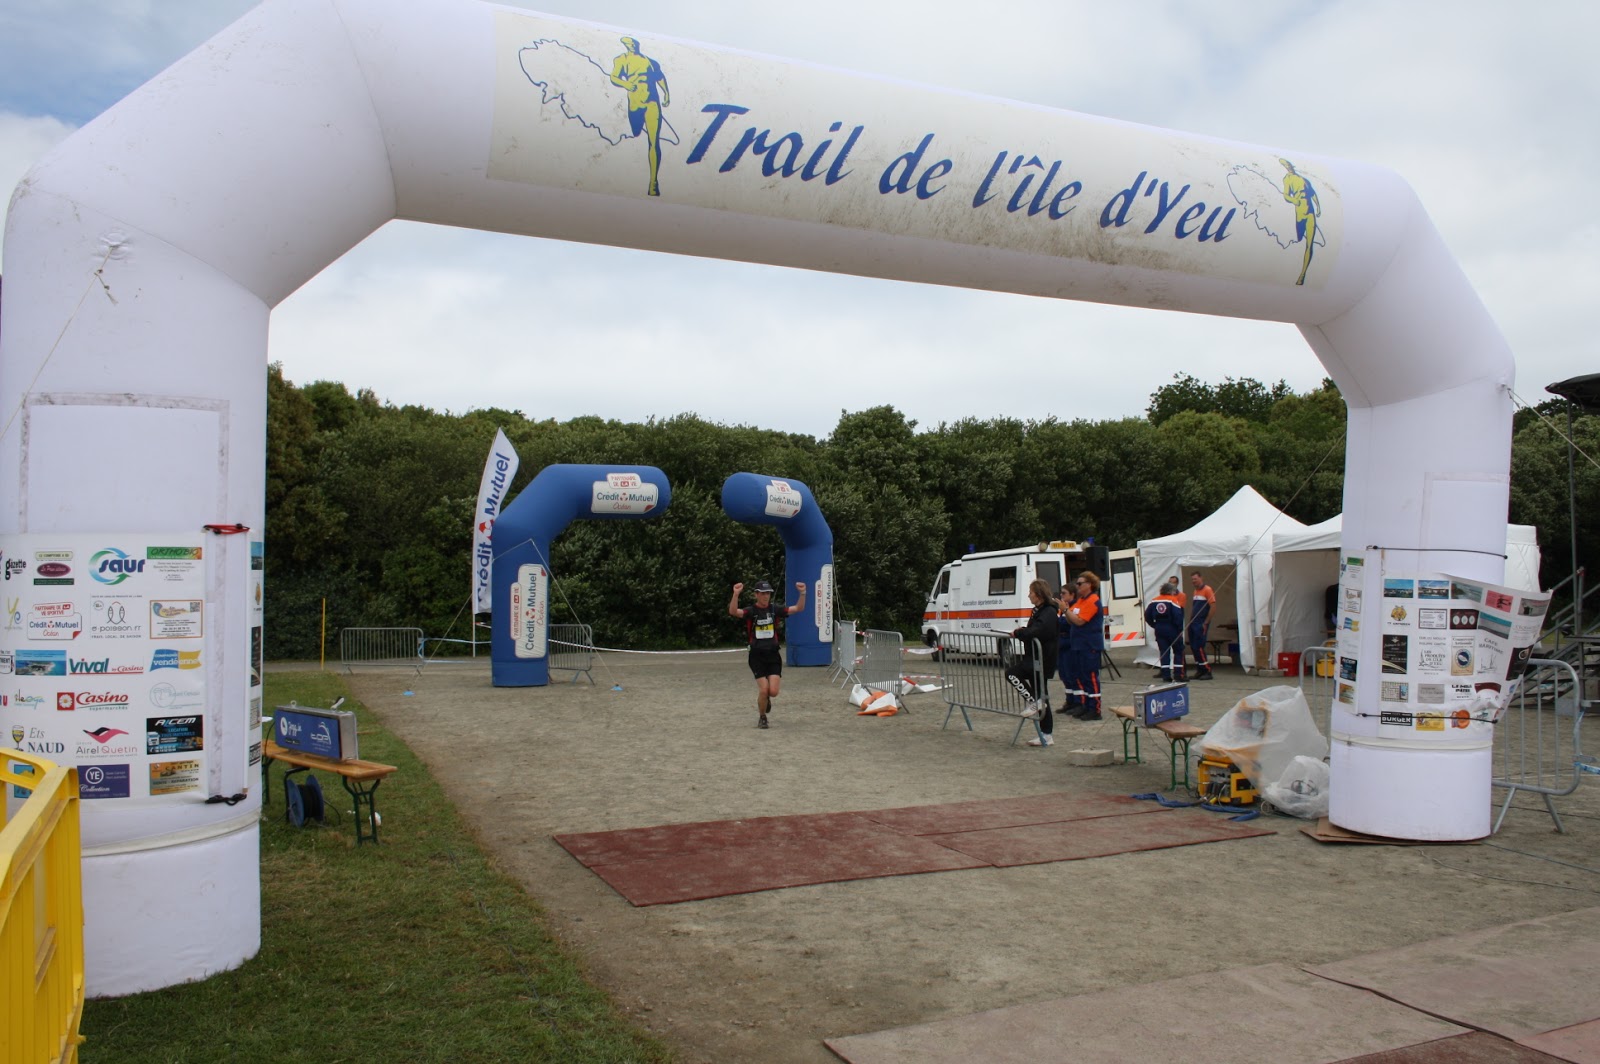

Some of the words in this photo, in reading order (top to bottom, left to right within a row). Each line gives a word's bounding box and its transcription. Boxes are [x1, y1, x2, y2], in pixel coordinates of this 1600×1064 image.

[686, 103, 864, 186] Trail
[878, 132, 954, 201] de
[972, 149, 1083, 220] l'île
[1100, 170, 1239, 244] d'Yeu
[484, 452, 511, 516] Mutuel
[597, 490, 620, 501] Crédit
[628, 494, 654, 502] Mutuel
[99, 558, 146, 573] saur
[527, 573, 537, 607] Mutuel
[536, 600, 545, 625] Océan
[29, 620, 47, 629] Crédit
[55, 621, 79, 629] Mutuel
[525, 620, 535, 651] Crédit
[69, 657, 110, 674] Vival
[117, 665, 144, 673] Casino
[76, 691, 129, 705] Casino
[29, 726, 46, 739] Ets
[27, 742, 65, 754] NAUD
[76, 746, 100, 755] Airel
[101, 745, 138, 754] Quetin
[89, 770, 101, 780] YE
